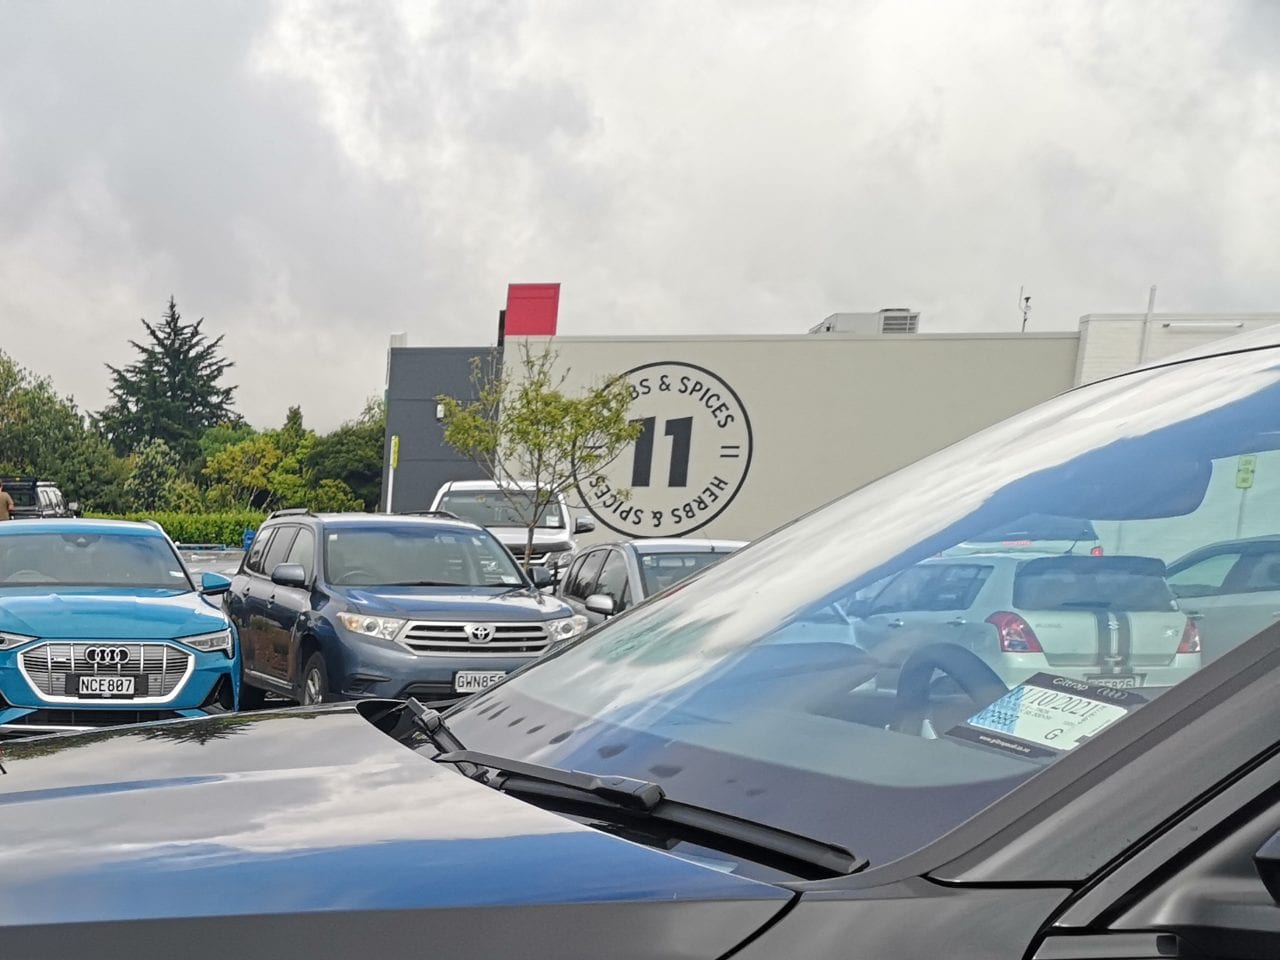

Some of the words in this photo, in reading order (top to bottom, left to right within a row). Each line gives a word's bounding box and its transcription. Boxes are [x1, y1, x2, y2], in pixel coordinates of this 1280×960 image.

[678, 376, 735, 429] SPICES
[628, 416, 693, 487] 11
[589, 475, 645, 525] SPICES
[671, 476, 728, 524] HERBS
[81, 679, 133, 692] NCE807
[1053, 677, 1088, 691] Giltrap
[1044, 728, 1064, 740] G
